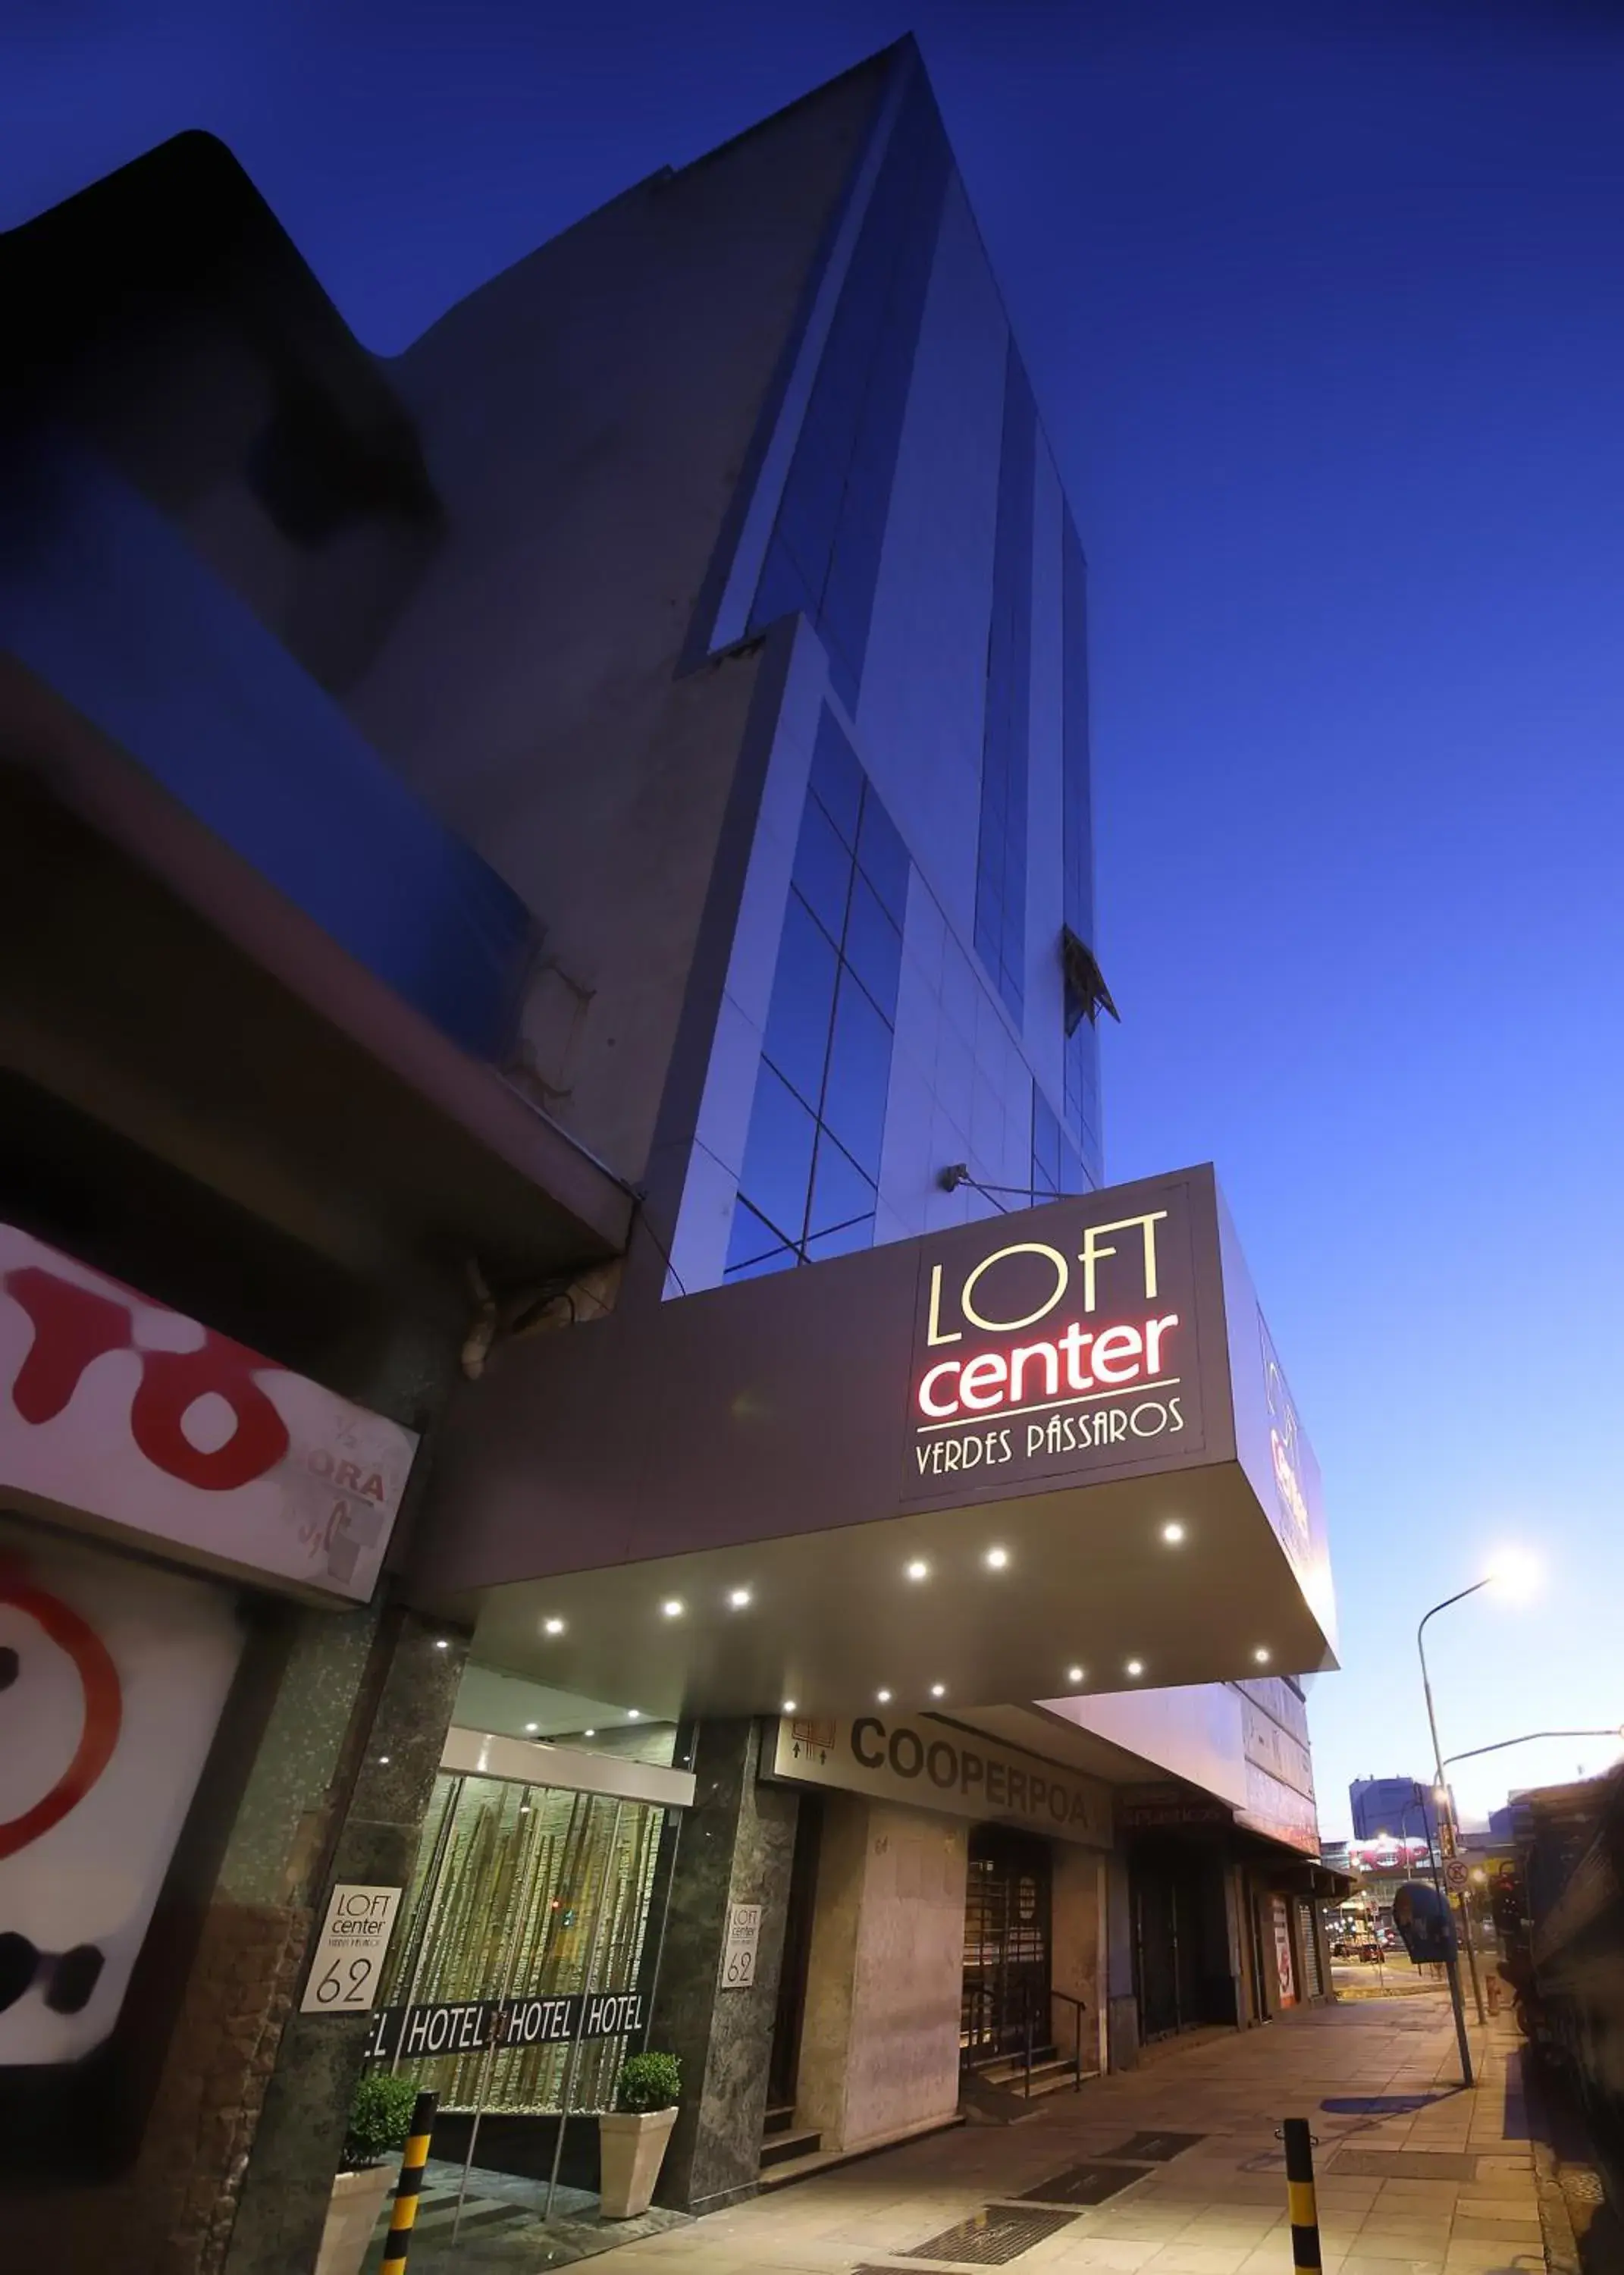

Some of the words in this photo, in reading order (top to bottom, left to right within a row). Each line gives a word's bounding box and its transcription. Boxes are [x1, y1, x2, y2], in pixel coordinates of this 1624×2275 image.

[926, 1210, 1168, 1347] LOFT
[917, 1313, 1180, 1418] center
[915, 1429, 1012, 1476] VERDES
[1027, 1398, 1184, 1458] PÁSSAROS
[850, 1716, 1089, 1829] COOPERPOA
[331, 1918, 387, 1935] center
[337, 1893, 392, 1918] LOFT
[316, 1957, 372, 2004] 62
[727, 1951, 751, 1982] 62
[407, 2005, 484, 2054] HOTEL
[506, 2000, 572, 2043] HOTEL
[588, 1994, 643, 2035] HOTEL
